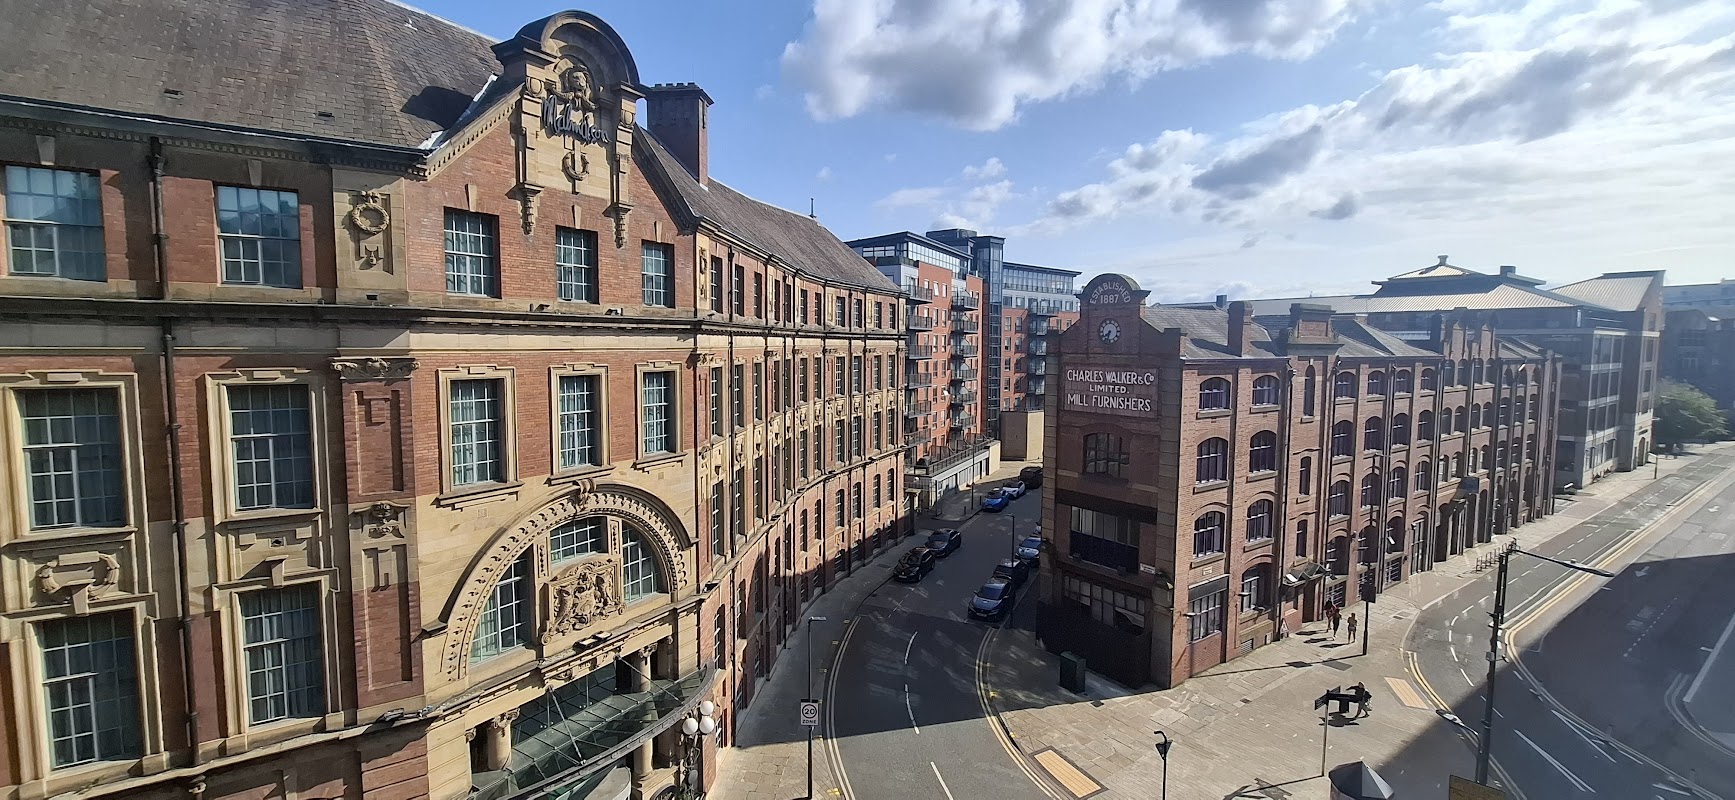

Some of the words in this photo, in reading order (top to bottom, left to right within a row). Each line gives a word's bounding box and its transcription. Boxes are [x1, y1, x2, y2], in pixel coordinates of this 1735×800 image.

[1090, 282, 1131, 304] ESTABLISHED
[1100, 294, 1119, 304] 1887
[1067, 369, 1104, 383] CHARLES
[1067, 393, 1089, 407] MILL
[1092, 395, 1151, 412] FURNISHERS
